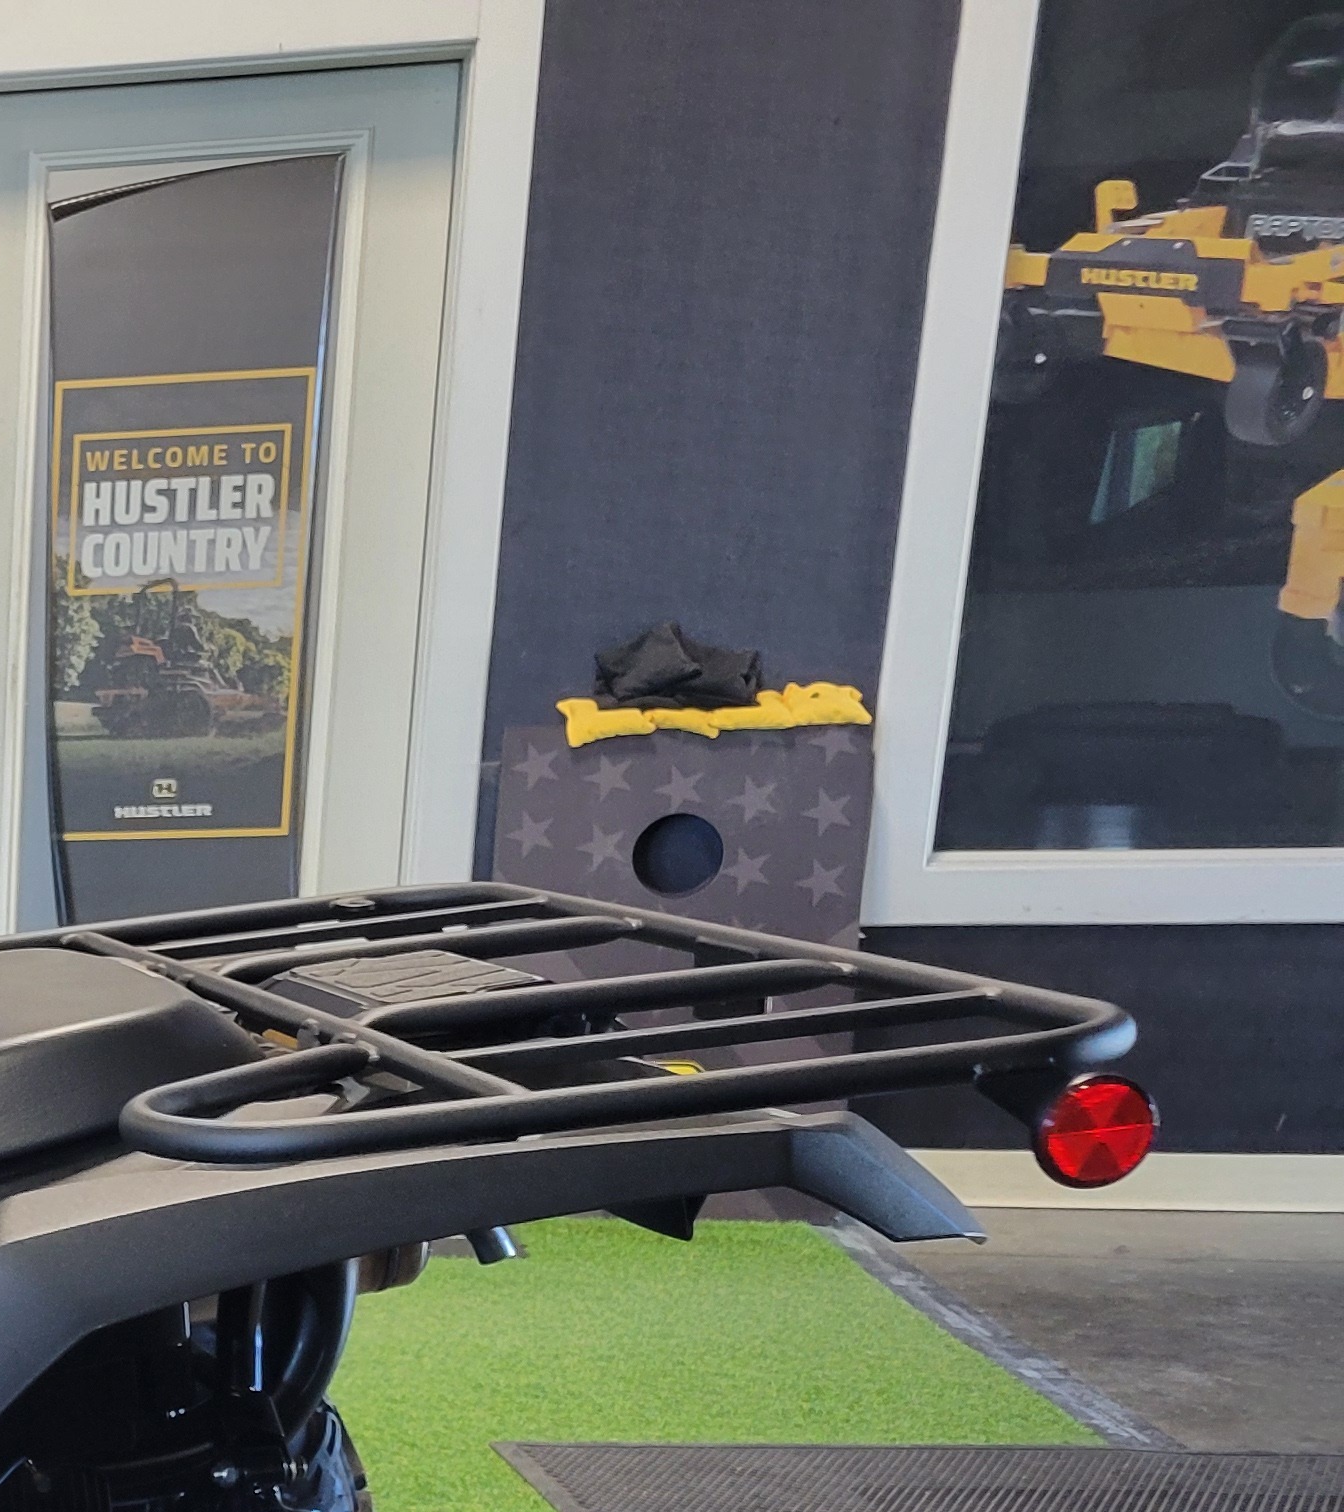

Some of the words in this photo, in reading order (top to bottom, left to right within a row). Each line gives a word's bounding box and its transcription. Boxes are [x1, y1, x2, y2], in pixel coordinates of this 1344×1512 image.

[1081, 267, 1199, 291] HUSTLER
[85, 444, 228, 472] WELCOME
[241, 441, 277, 464] TO
[82, 473, 276, 527] HUSTLER
[81, 526, 272, 578] COUNTRY
[114, 804, 212, 818] HUSTLER
